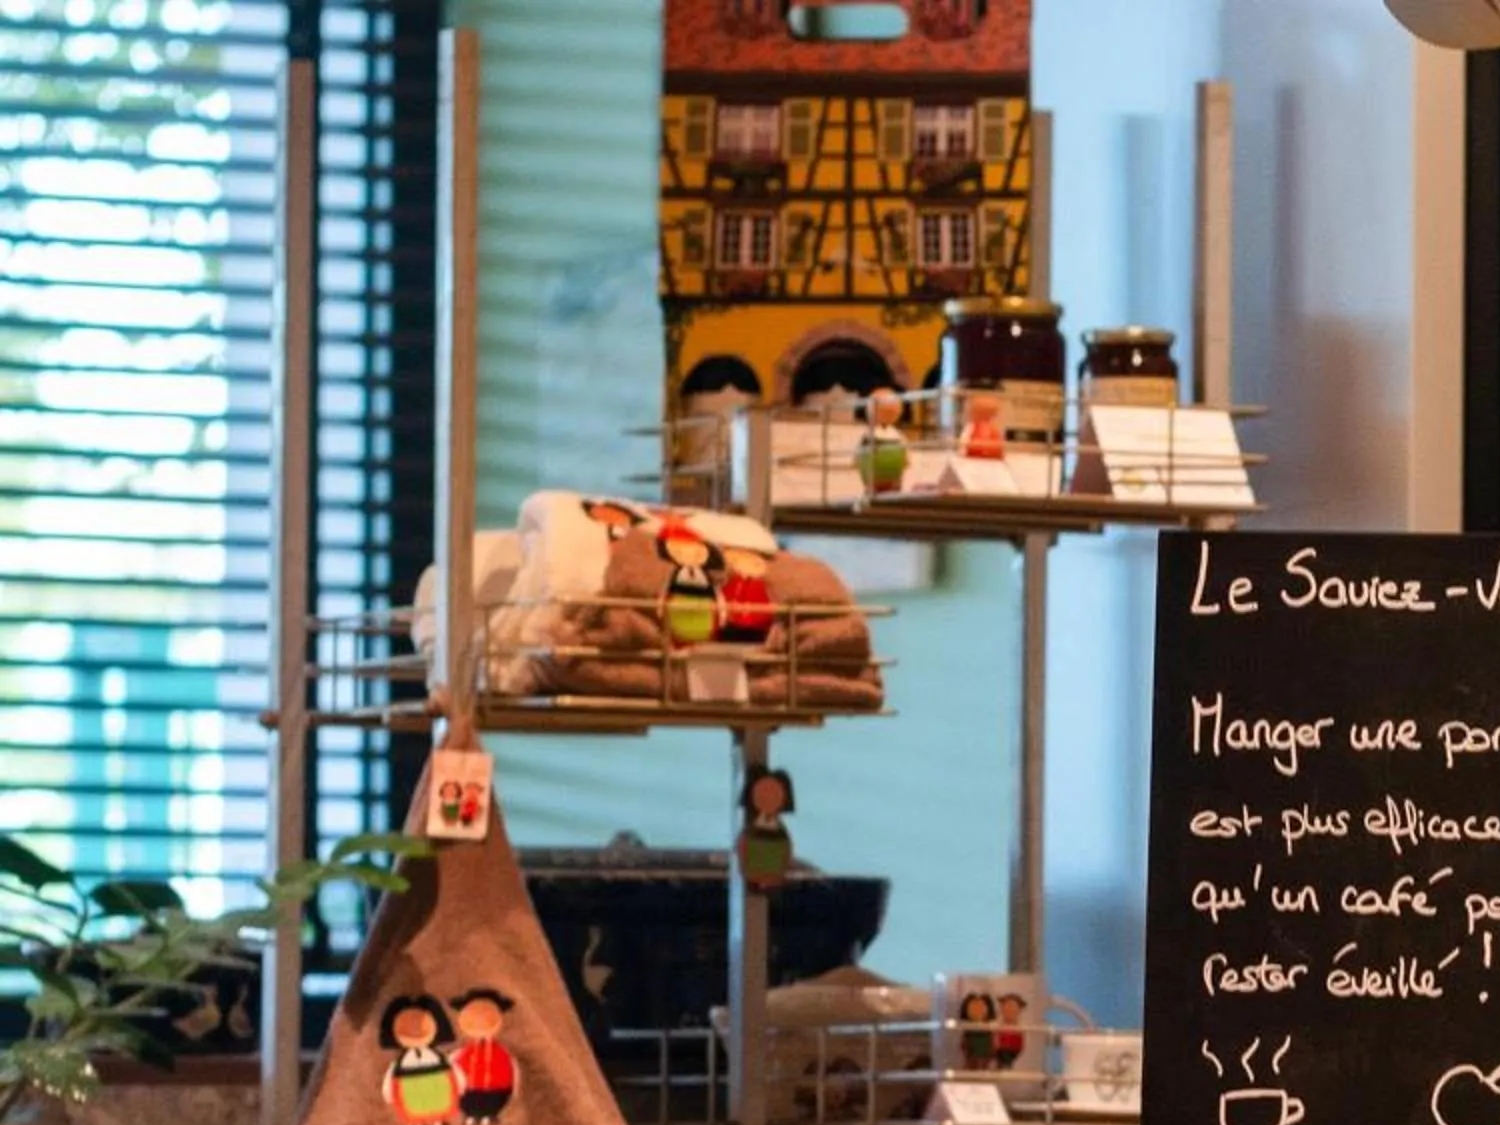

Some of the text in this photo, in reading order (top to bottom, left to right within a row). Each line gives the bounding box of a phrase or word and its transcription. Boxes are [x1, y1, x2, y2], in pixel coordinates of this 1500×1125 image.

[1190, 540, 1259, 614] Le
[1191, 692, 1335, 776] Manger
[1350, 719, 1422, 750] une
[1189, 804, 1263, 837] est
[1281, 804, 1351, 855] plus
[1191, 863, 1320, 923] qu'un
[1340, 866, 1453, 916] café
[1203, 953, 1308, 996] rester
[1326, 942, 1460, 999] éveillé
